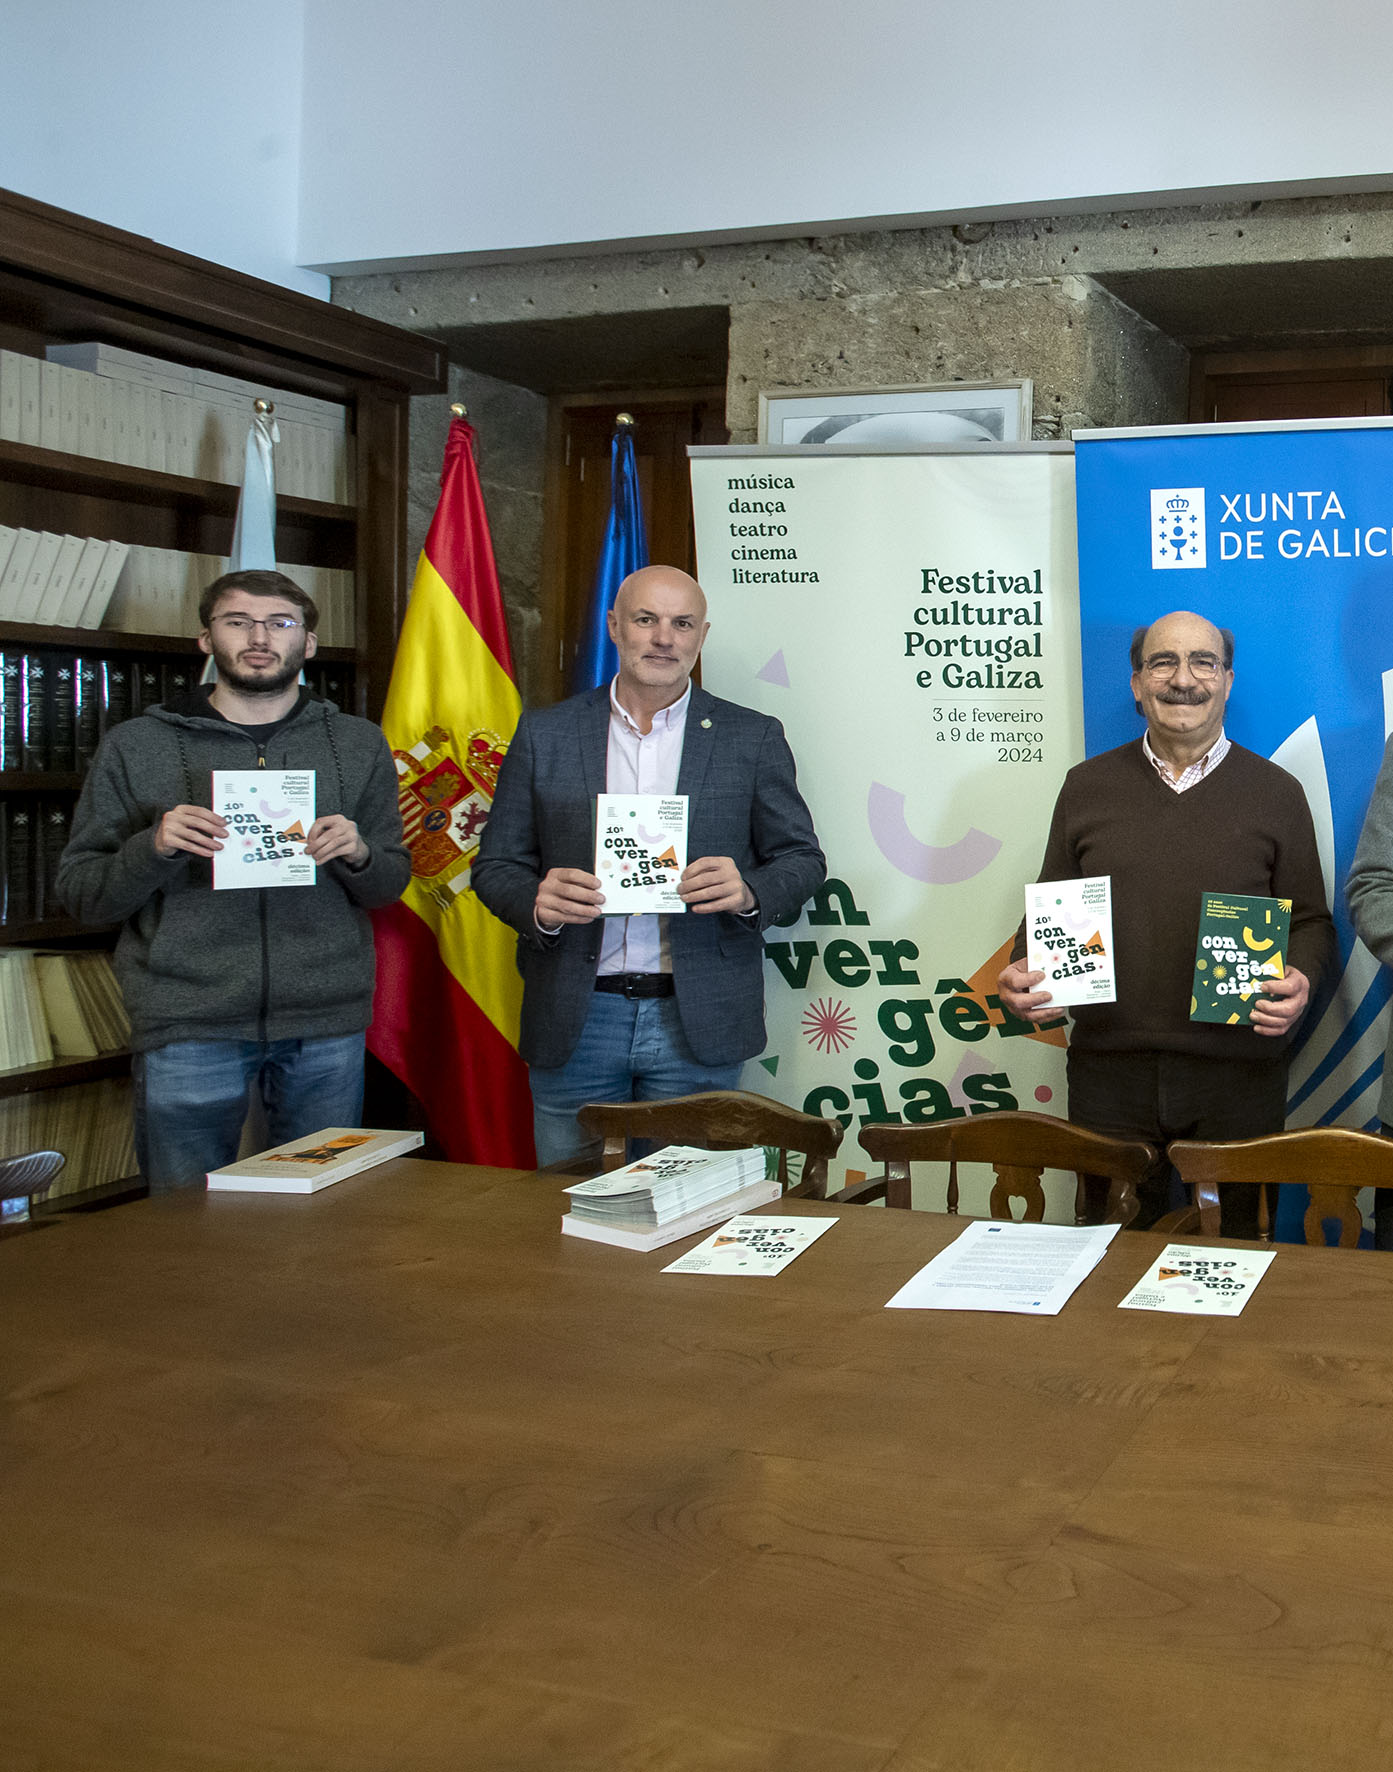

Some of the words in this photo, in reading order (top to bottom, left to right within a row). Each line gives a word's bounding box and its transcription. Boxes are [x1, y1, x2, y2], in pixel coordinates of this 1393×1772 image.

[728, 474, 795, 490] música
[728, 498, 786, 516] dança
[1220, 491, 1346, 522] XUNTA
[730, 522, 788, 536] teatro
[731, 545, 798, 560] cinema
[1220, 530, 1264, 560] DE
[732, 568, 820, 584] literatura
[921, 568, 1043, 594] Festival
[914, 600, 1043, 626] cultural
[904, 632, 1043, 663] Portugal
[916, 671, 932, 688] e
[942, 664, 1044, 688] Galiza
[932, 708, 942, 722] 3
[948, 708, 966, 722] de
[972, 708, 1043, 722] fevereiro
[936, 732, 945, 742] a
[950, 728, 960, 742] 9
[966, 728, 984, 742] de
[990, 732, 1043, 746] março
[998, 748, 1043, 762] 2024
[224, 814, 260, 824] con
[234, 824, 272, 836] ver
[262, 831, 306, 848] gên
[604, 838, 638, 848] con
[243, 848, 294, 863] cias
[614, 849, 648, 860] ver
[638, 856, 678, 874] gên
[621, 872, 668, 888] cias
[1034, 926, 1066, 940] con
[1044, 937, 1076, 950] ver
[1202, 936, 1238, 950] con
[1068, 943, 1104, 963] gên
[1212, 950, 1248, 963] ver
[764, 938, 920, 990] ver
[1052, 961, 1096, 980] cias
[1236, 960, 1279, 980] gên
[803, 1057, 1019, 1130] cias
[1178, 1260, 1237, 1270] cias
